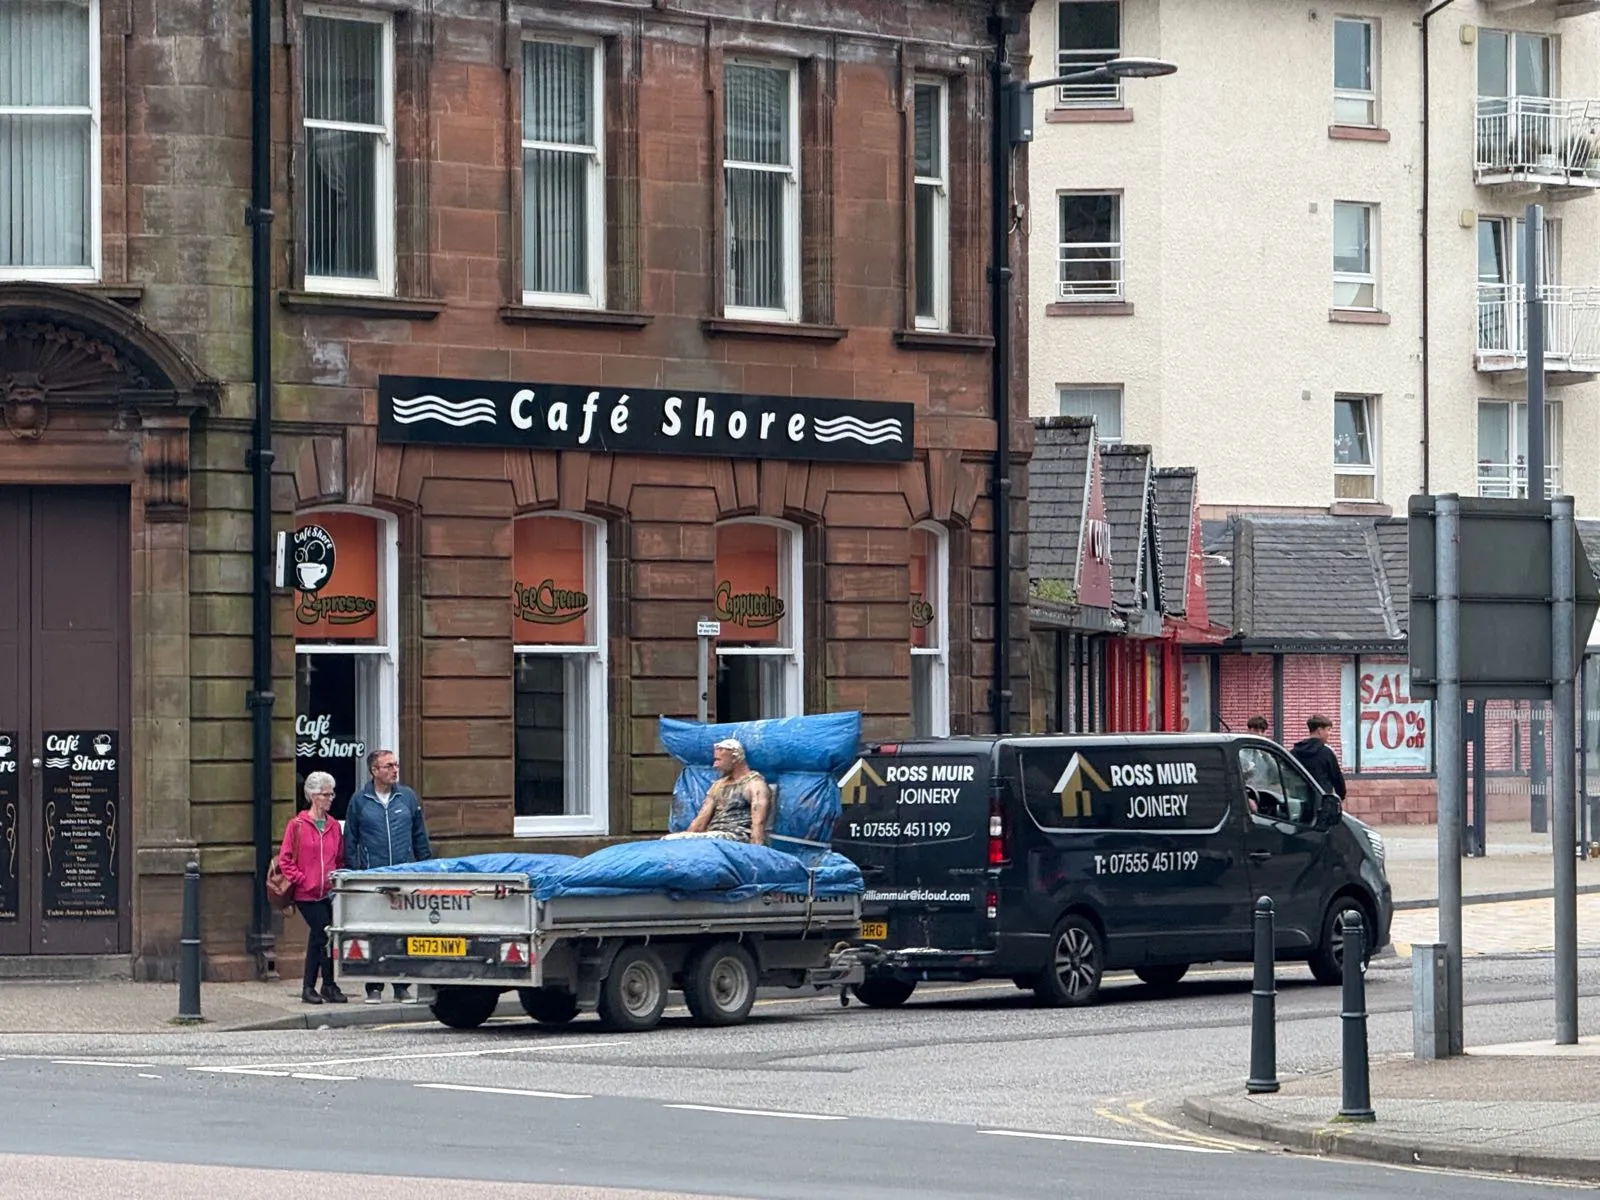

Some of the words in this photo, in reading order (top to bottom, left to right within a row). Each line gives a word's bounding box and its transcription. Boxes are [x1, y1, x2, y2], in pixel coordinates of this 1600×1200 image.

[510, 389, 630, 444] Café
[661, 396, 806, 442] Shore
[294, 527, 311, 544] Café
[312, 527, 333, 550] Shore
[296, 591, 377, 625] Espresso
[715, 580, 785, 627] Cappuccino
[1360, 673, 1424, 705] SAL
[295, 714, 332, 741] Café
[1360, 710, 1425, 750] 70%
[46, 734, 80, 756] Café
[318, 737, 365, 758] Shore
[1406, 732, 1426, 749] off
[72, 754, 116, 771] Shore
[886, 766, 929, 782] ROSS
[931, 765, 974, 782] MUIR
[1110, 764, 1154, 787] ROSS
[1156, 763, 1198, 785] MUIR
[896, 788, 960, 805] JOINERY
[1126, 794, 1188, 819] JOINERY
[850, 823, 860, 837] T:
[863, 822, 900, 837] 07555
[903, 822, 951, 837] 451199
[1094, 855, 1107, 875] T:
[1109, 852, 1149, 874] 07555
[1152, 851, 1199, 872] 451199
[404, 894, 473, 911] NUGENT
[862, 924, 884, 937] HRG
[412, 939, 439, 953] SH73
[441, 940, 462, 954] NWY
